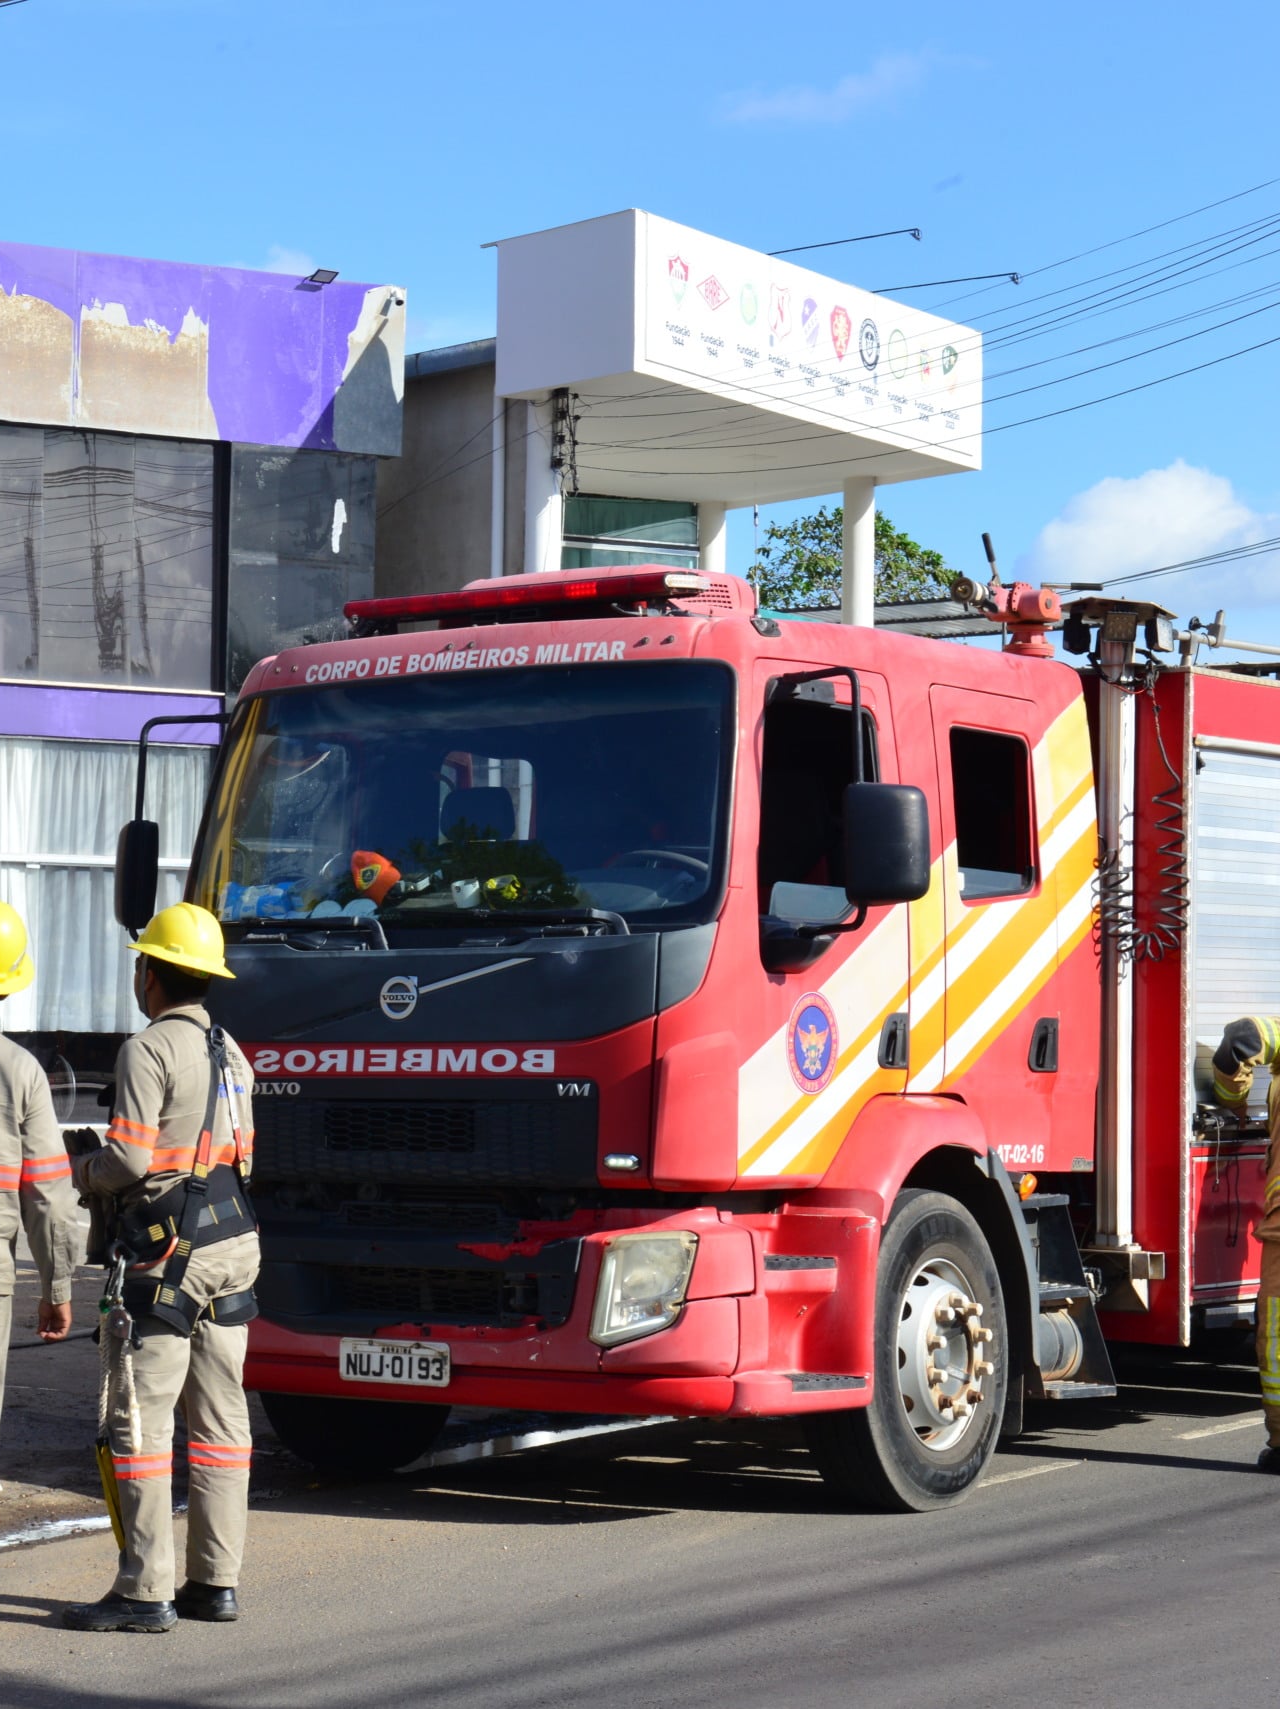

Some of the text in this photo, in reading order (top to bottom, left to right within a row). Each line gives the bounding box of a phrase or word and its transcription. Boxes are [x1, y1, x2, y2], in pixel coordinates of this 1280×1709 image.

[305, 640, 627, 684] CORPO DE BOMBEIROS MILITAR
[382, 993, 415, 1002] VOLVO
[251, 1082, 301, 1096] OLVO
[556, 1083, 591, 1097] VM
